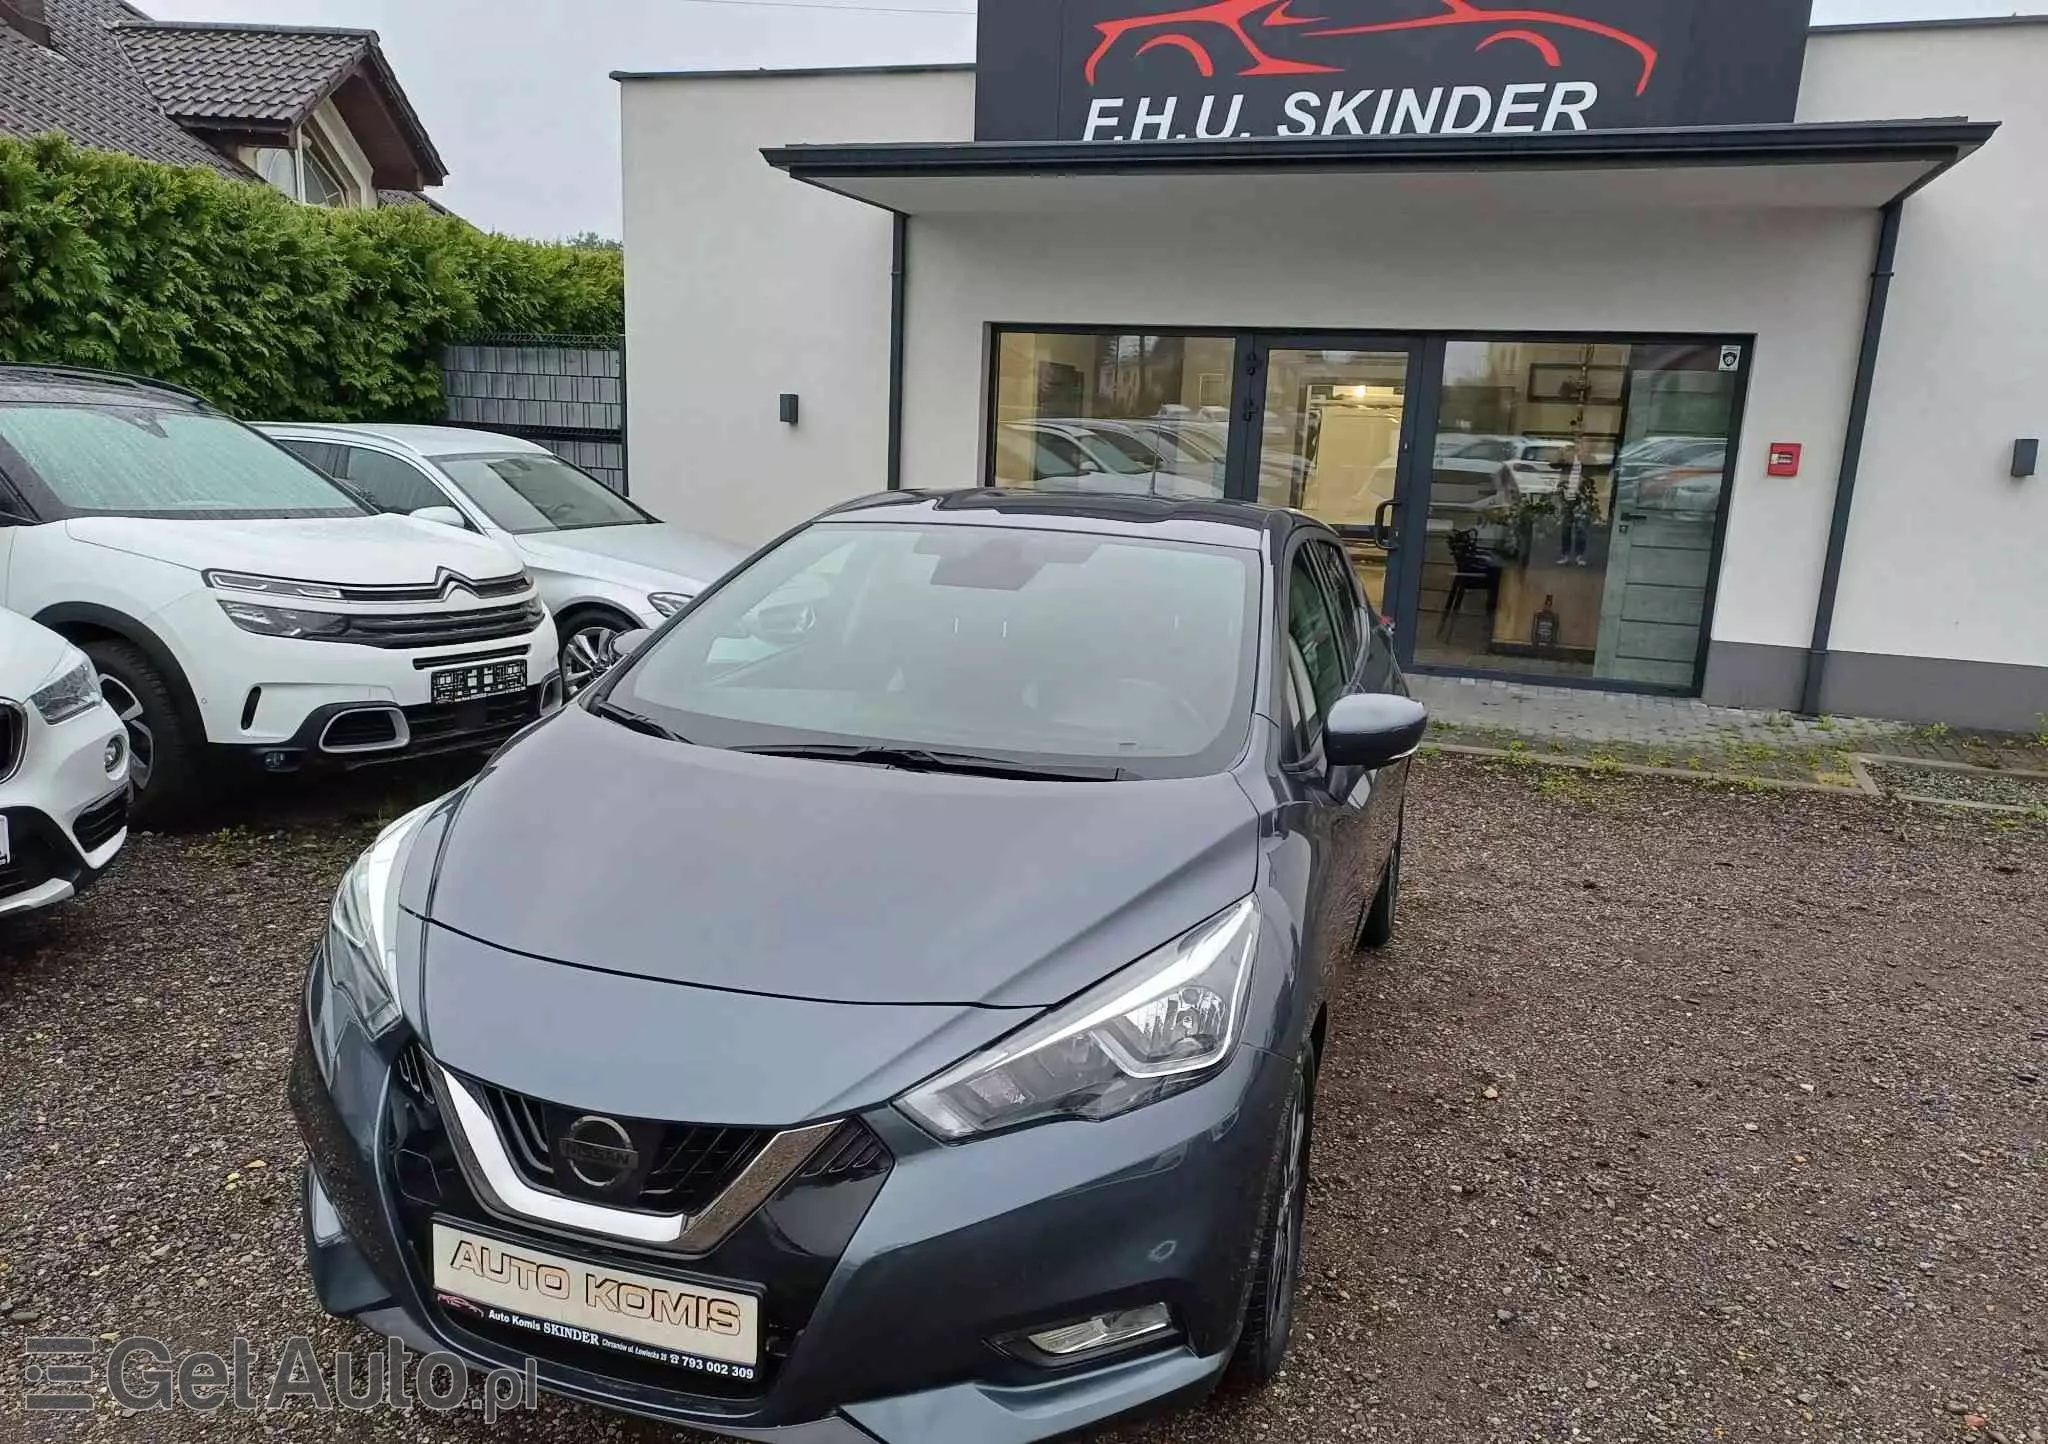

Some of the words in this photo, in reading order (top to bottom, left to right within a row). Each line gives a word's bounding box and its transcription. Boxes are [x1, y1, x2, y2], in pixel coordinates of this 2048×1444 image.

[1083, 94, 1251, 141] F.H.U.
[1277, 81, 1599, 136] SKINDER
[563, 1141, 630, 1166] NISSAN
[450, 1239, 571, 1300] AUTO
[585, 1272, 742, 1336] KOMIS
[488, 1309, 510, 1323] Auto
[512, 1315, 541, 1331] Komis
[543, 1321, 600, 1346] SKINDER
[681, 1355, 703, 1370] 793
[706, 1361, 729, 1375] 002
[731, 1366, 754, 1379] 309
